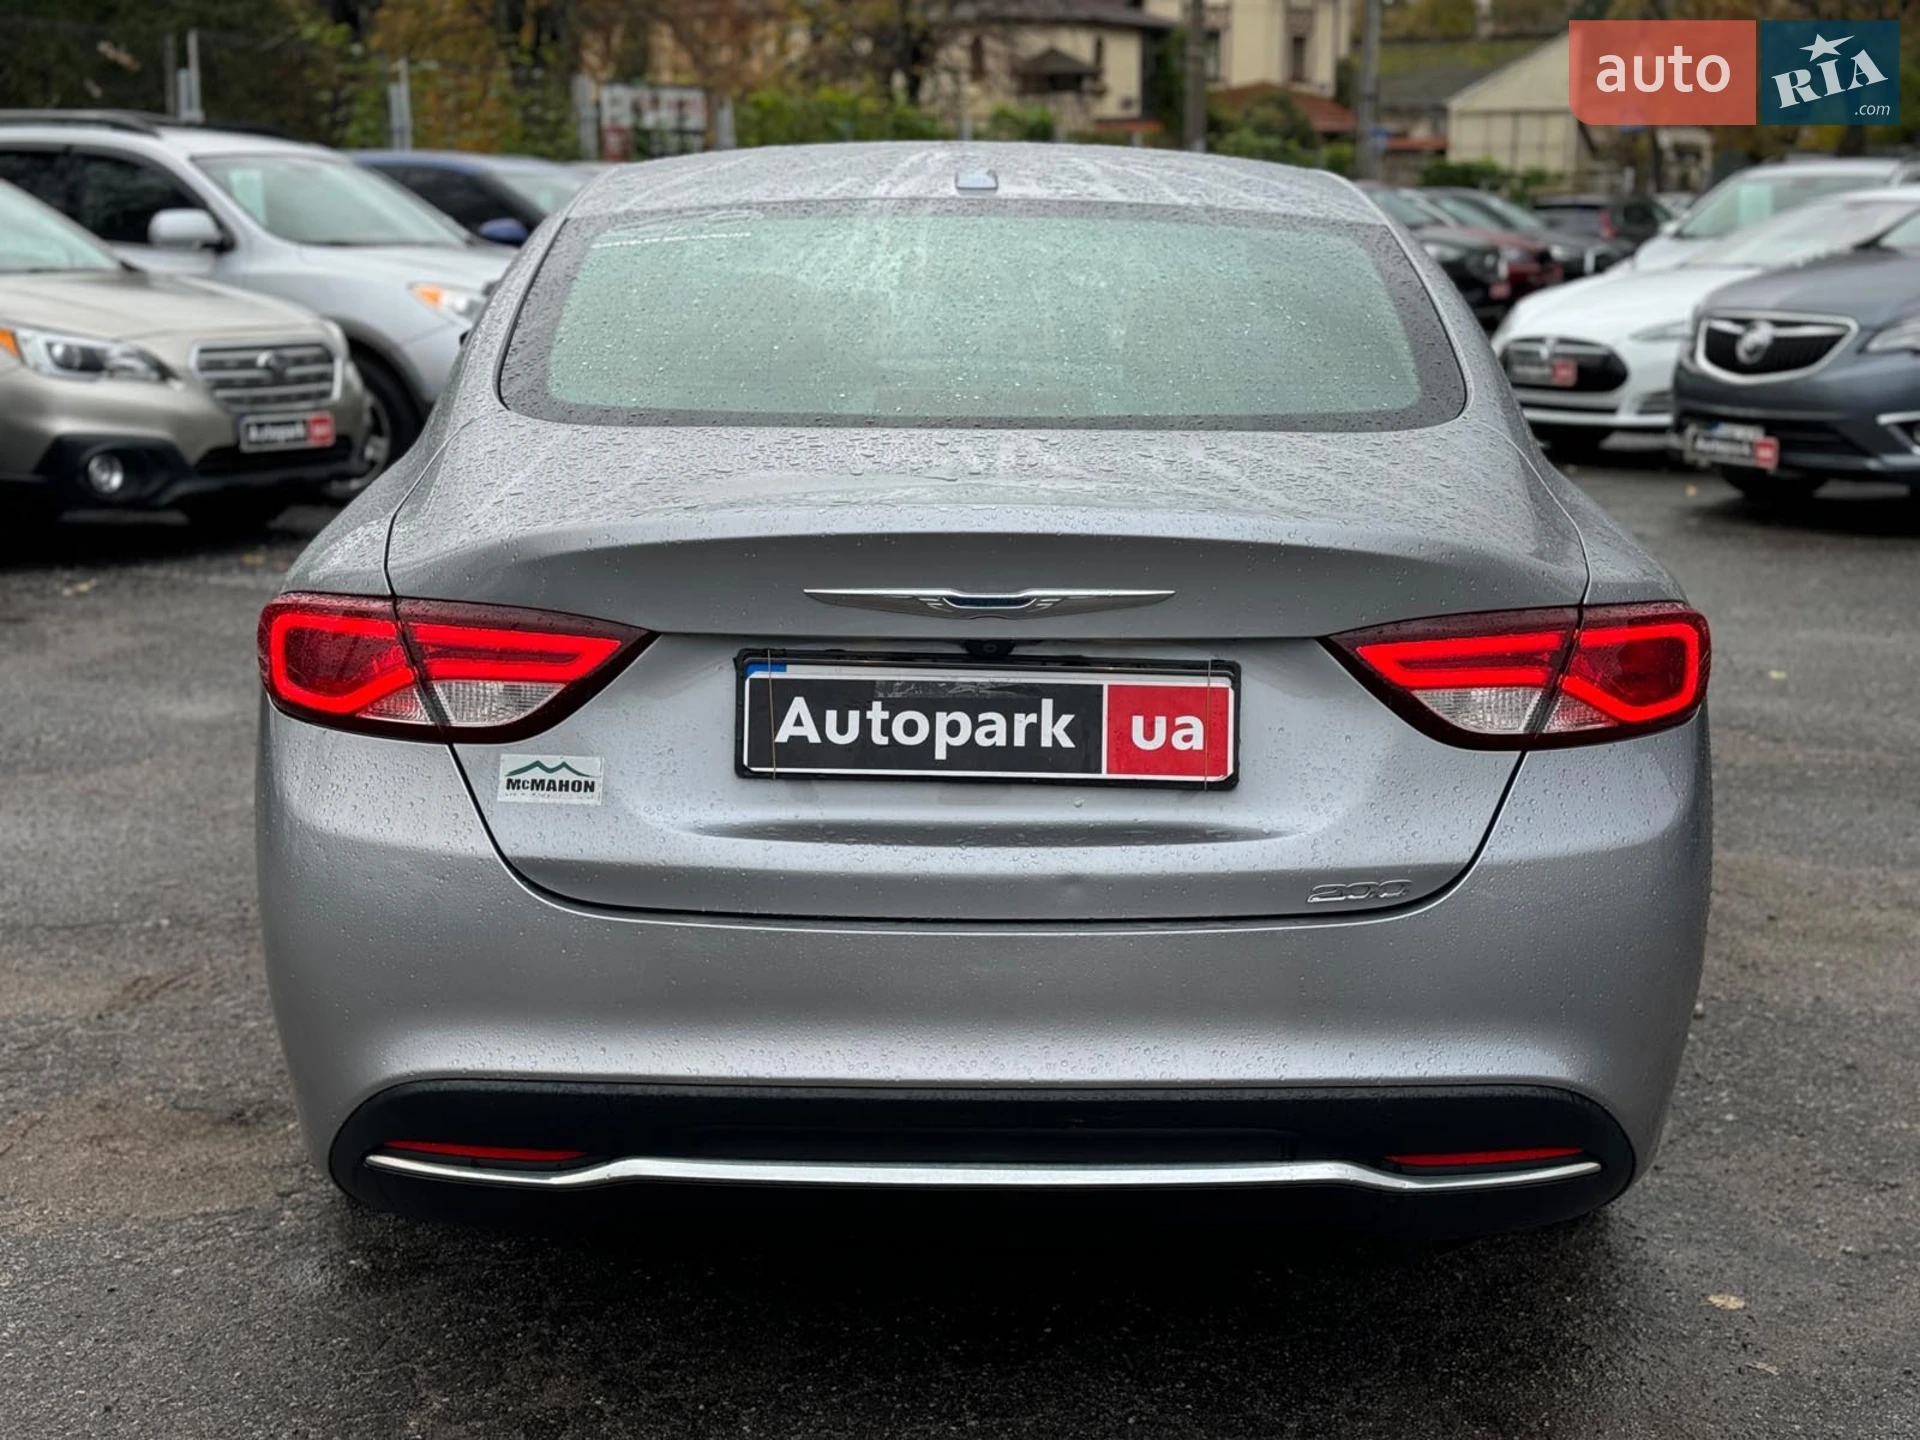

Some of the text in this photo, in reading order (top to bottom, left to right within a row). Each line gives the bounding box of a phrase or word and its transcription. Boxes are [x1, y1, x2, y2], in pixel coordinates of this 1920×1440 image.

[774, 696, 1204, 760] Autopark ua
[505, 778, 595, 793] McMAHON
[1307, 879, 1412, 904] 200
